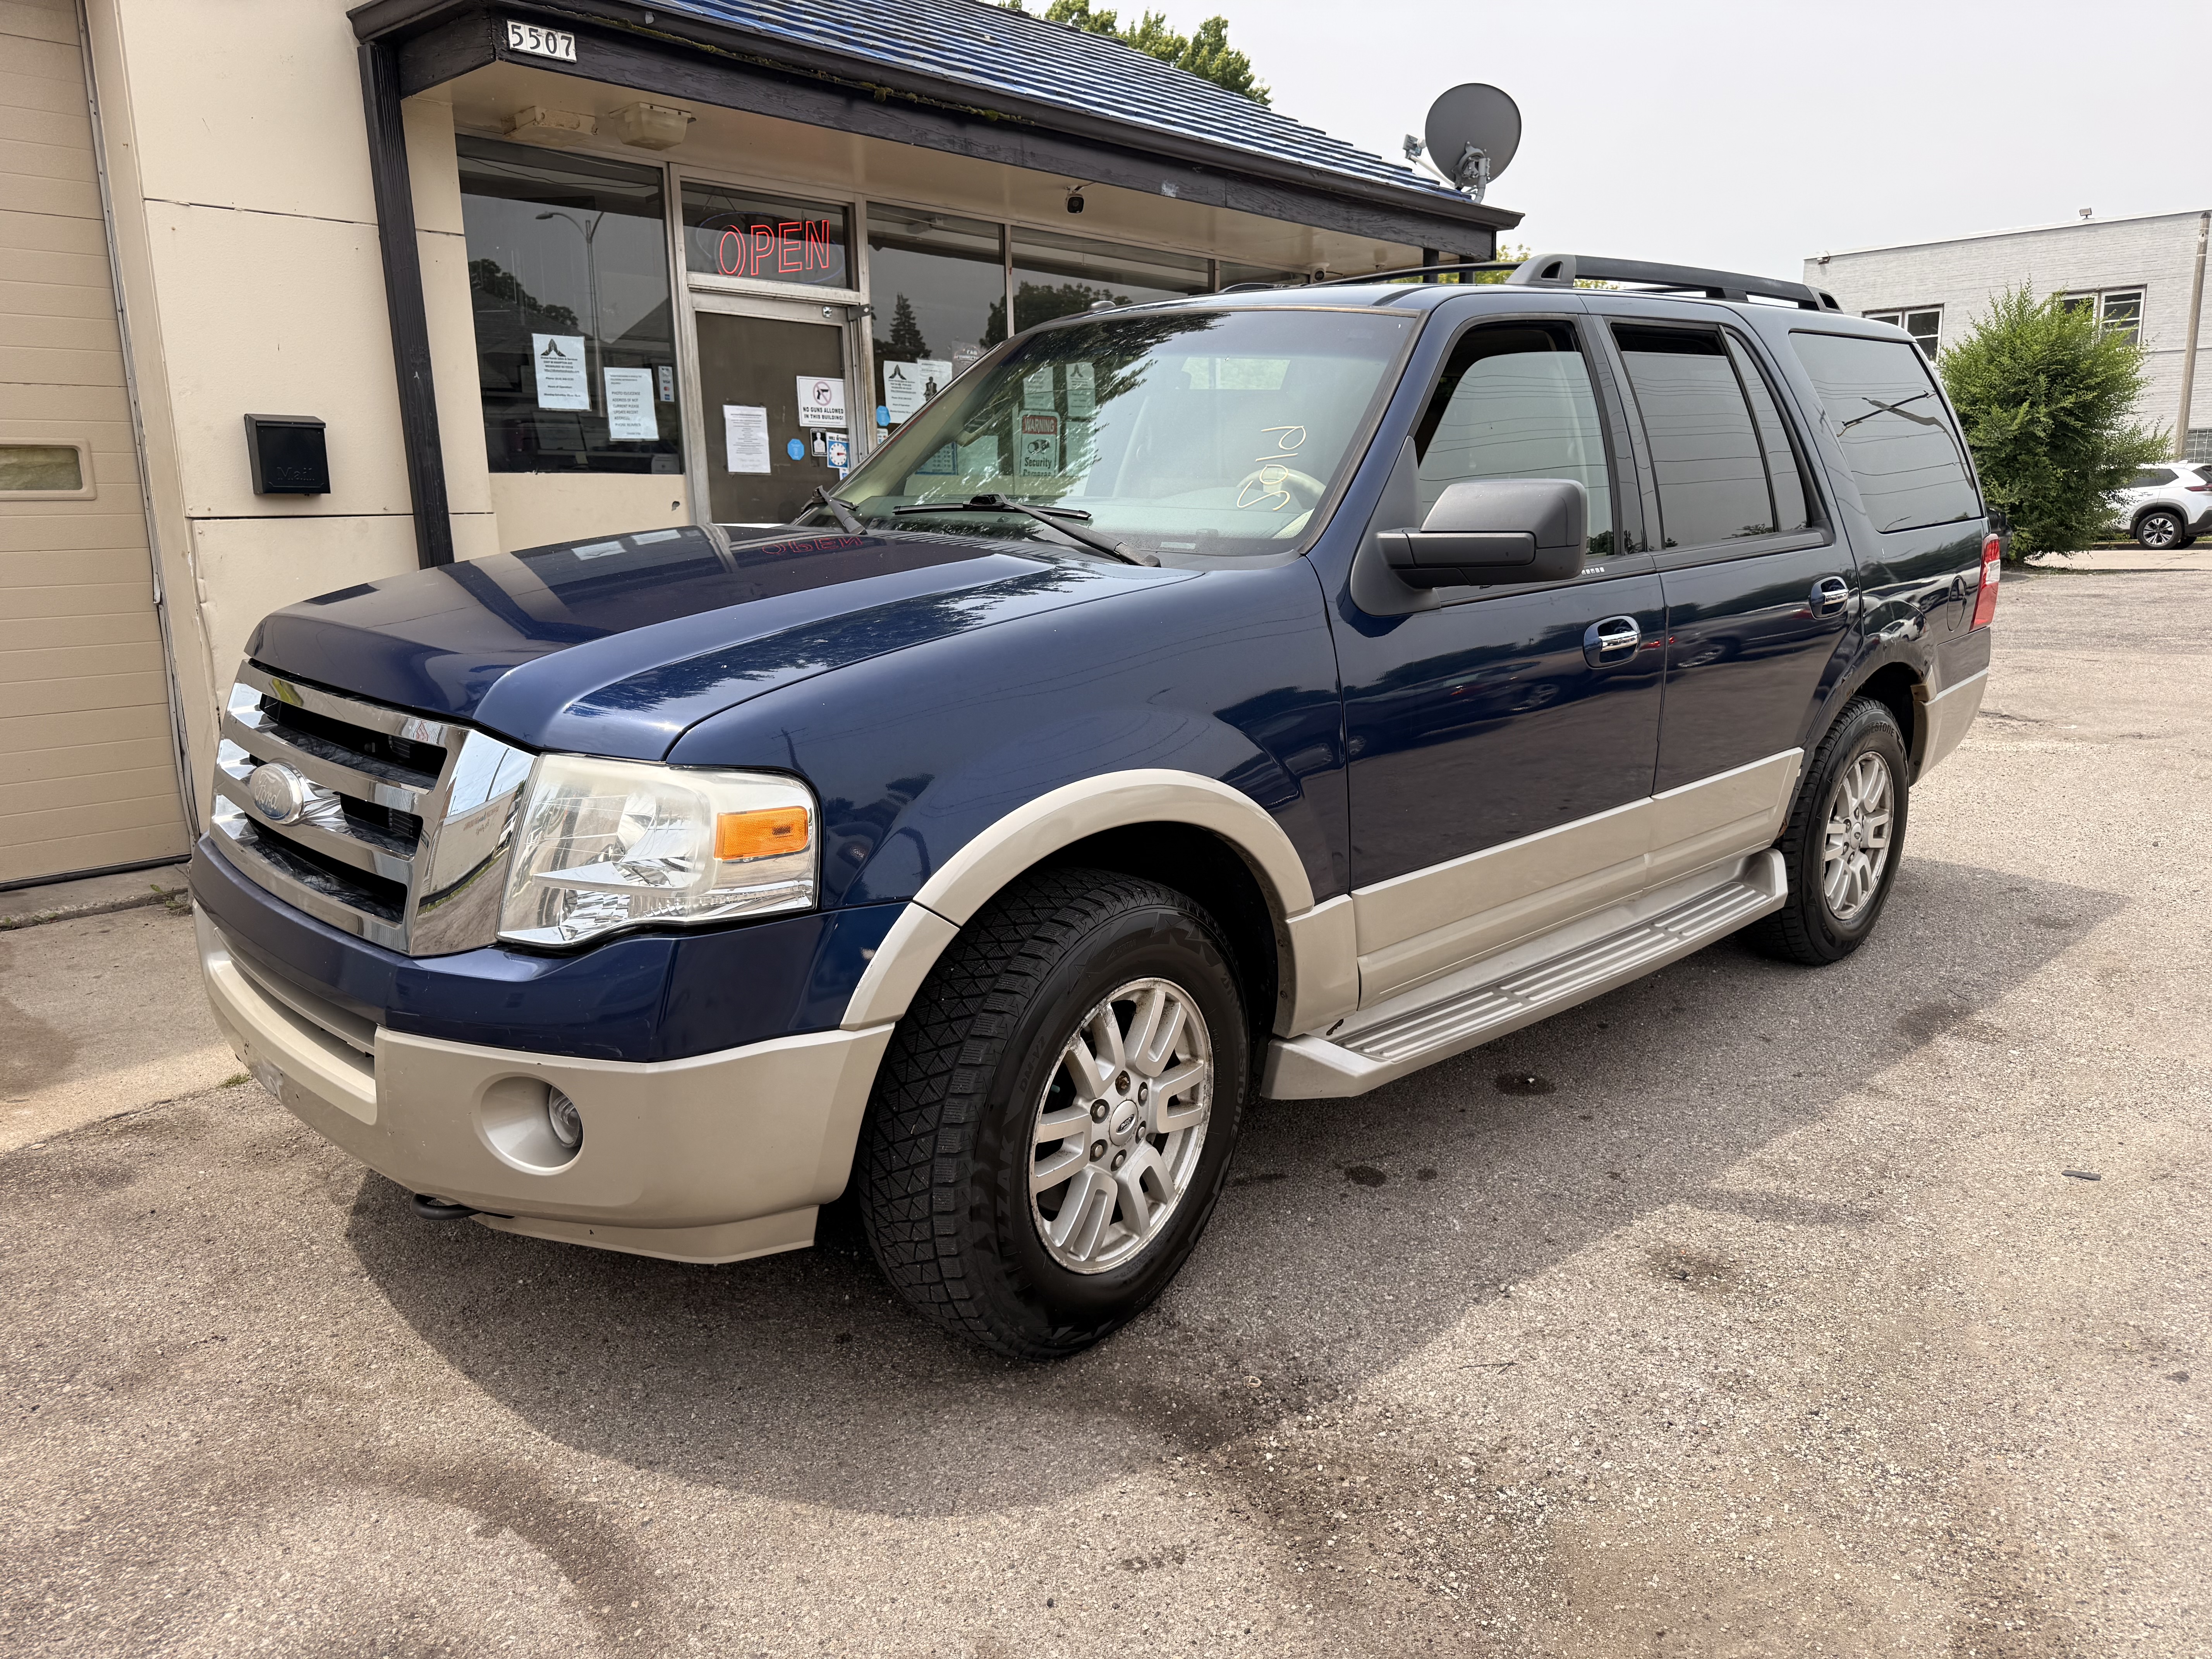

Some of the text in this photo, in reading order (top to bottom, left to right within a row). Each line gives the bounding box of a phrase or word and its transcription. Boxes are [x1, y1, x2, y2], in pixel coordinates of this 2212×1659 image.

[511, 24, 573, 57] 5507
[714, 219, 829, 278] OPEN
[1024, 417, 1055, 433] WARNING
[1024, 457, 1052, 469] Security
[1237, 425, 1306, 511] Sold
[255, 770, 281, 810] Ford
[1020, 1036, 1046, 1093] DM-V2
[1220, 973, 1246, 1140] BRIDESTONE
